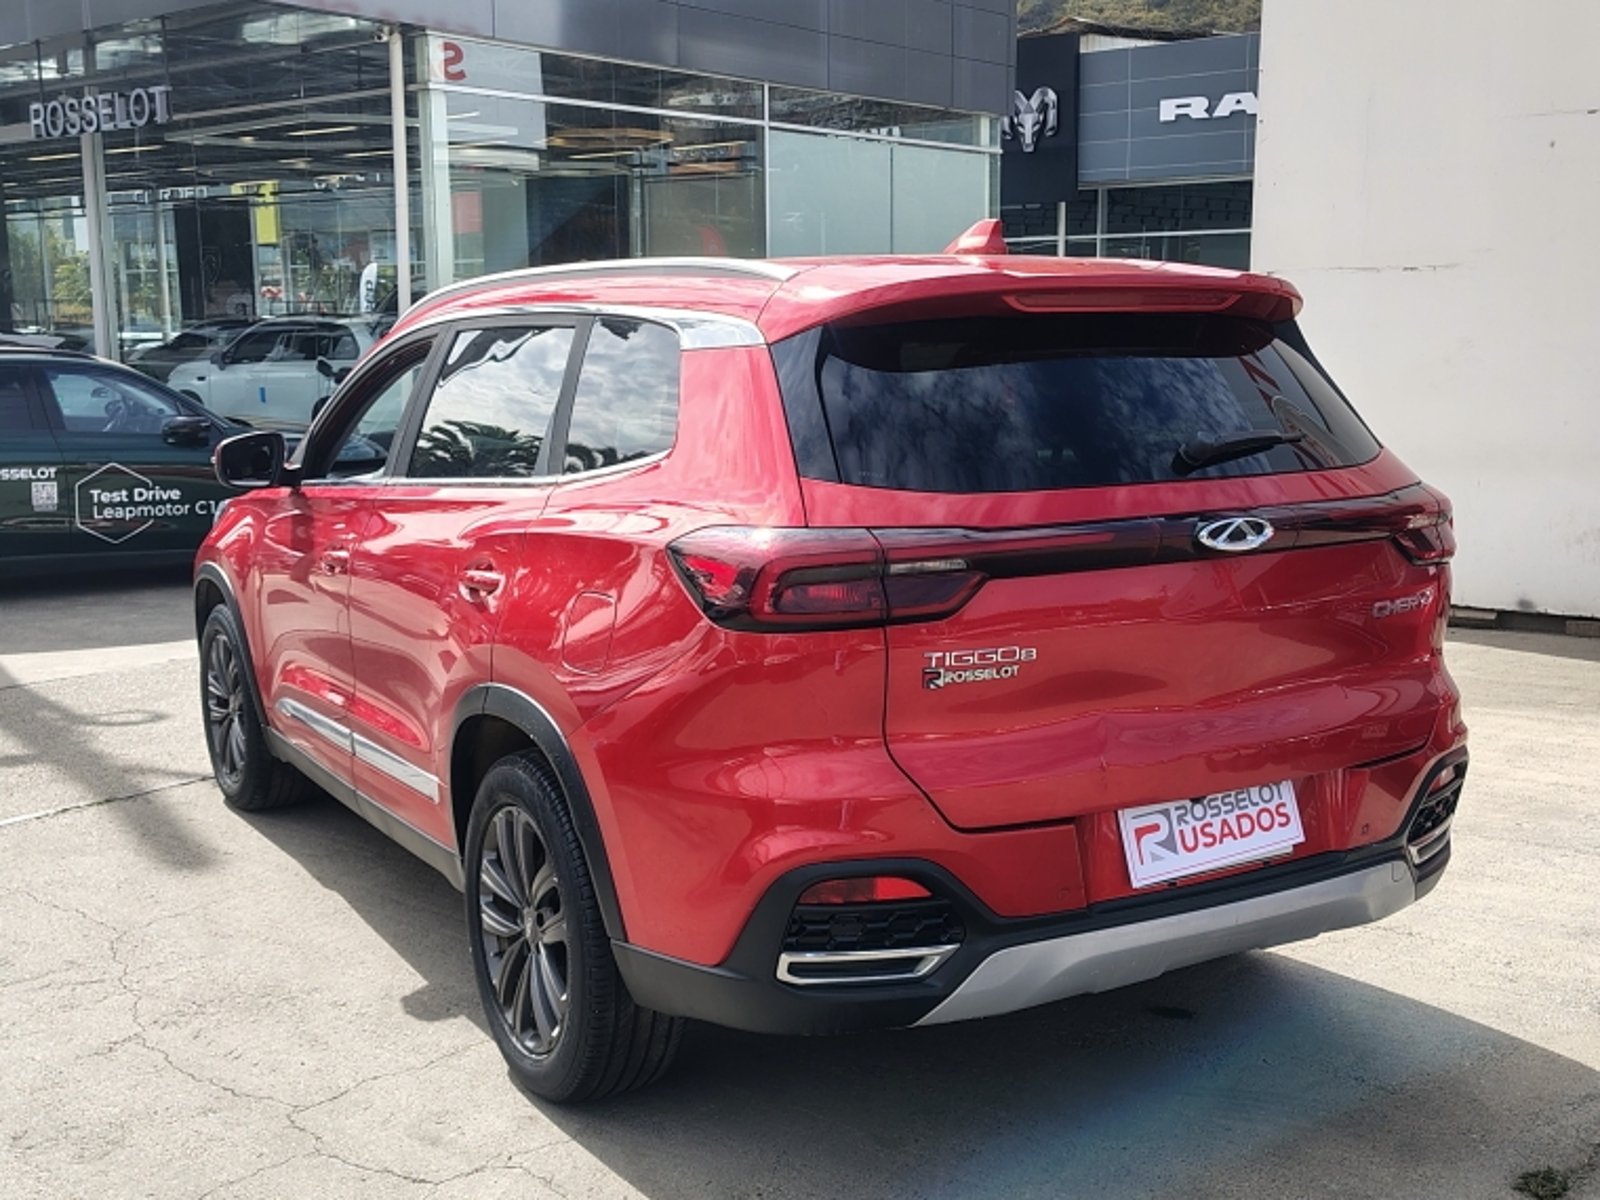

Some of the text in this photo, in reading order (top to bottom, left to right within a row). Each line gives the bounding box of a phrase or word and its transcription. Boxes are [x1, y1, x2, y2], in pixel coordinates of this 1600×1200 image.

[30, 85, 172, 138] ROSSELOT
[0, 467, 57, 481] SSELOT
[90, 486, 182, 503] Test Drive
[93, 502, 189, 520] Leapmotor
[944, 665, 1020, 683] ROSSELOT
[1175, 783, 1284, 826] ROSSELOT
[1179, 802, 1292, 854] USADOS
